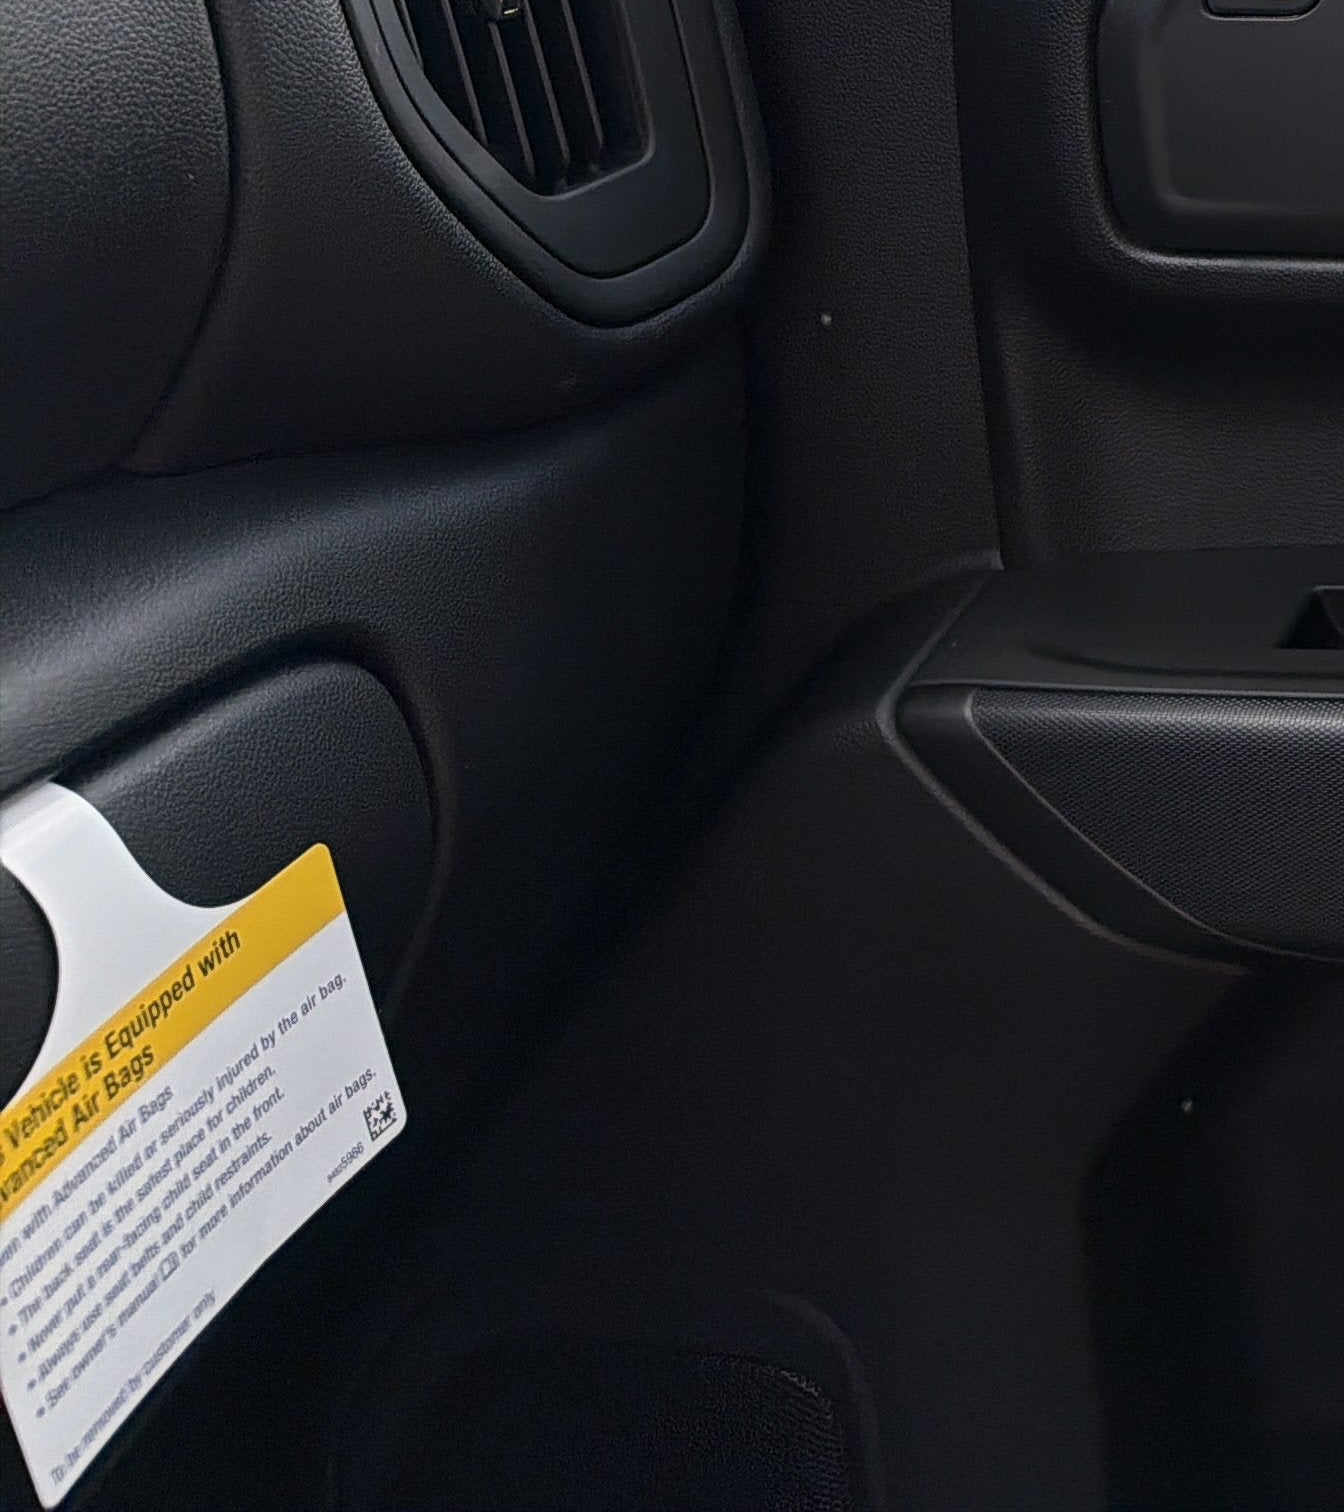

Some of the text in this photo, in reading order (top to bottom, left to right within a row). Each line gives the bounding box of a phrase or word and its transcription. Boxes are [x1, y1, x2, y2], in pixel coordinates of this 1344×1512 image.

[3, 930, 241, 1148] Vehicle is Equipped with
[72, 1091, 100, 1133] Air
[103, 1044, 154, 1101] Bags
[107, 1152, 144, 1196] killed
[159, 1086, 214, 1146] seriously
[215, 1042, 260, 1093] injured
[260, 1029, 276, 1051] by
[277, 1011, 299, 1035] the
[300, 994, 316, 1017] air
[318, 973, 347, 1002] bag.
[117, 1116, 138, 1146] Air
[138, 1085, 174, 1125] Bags
[173, 1127, 207, 1168] place
[206, 1109, 224, 1133] for
[225, 1064, 276, 1115] children.
[192, 1145, 219, 1181] seat
[218, 1134, 233, 1155] in
[231, 1117, 252, 1144] the
[252, 1086, 285, 1122] front.
[229, 1140, 294, 1206] information
[294, 1108, 327, 1147] about
[328, 1094, 344, 1116] air
[344, 1068, 377, 1099] bags.
[184, 1180, 214, 1220] child
[215, 1129, 273, 1189] restraints.
